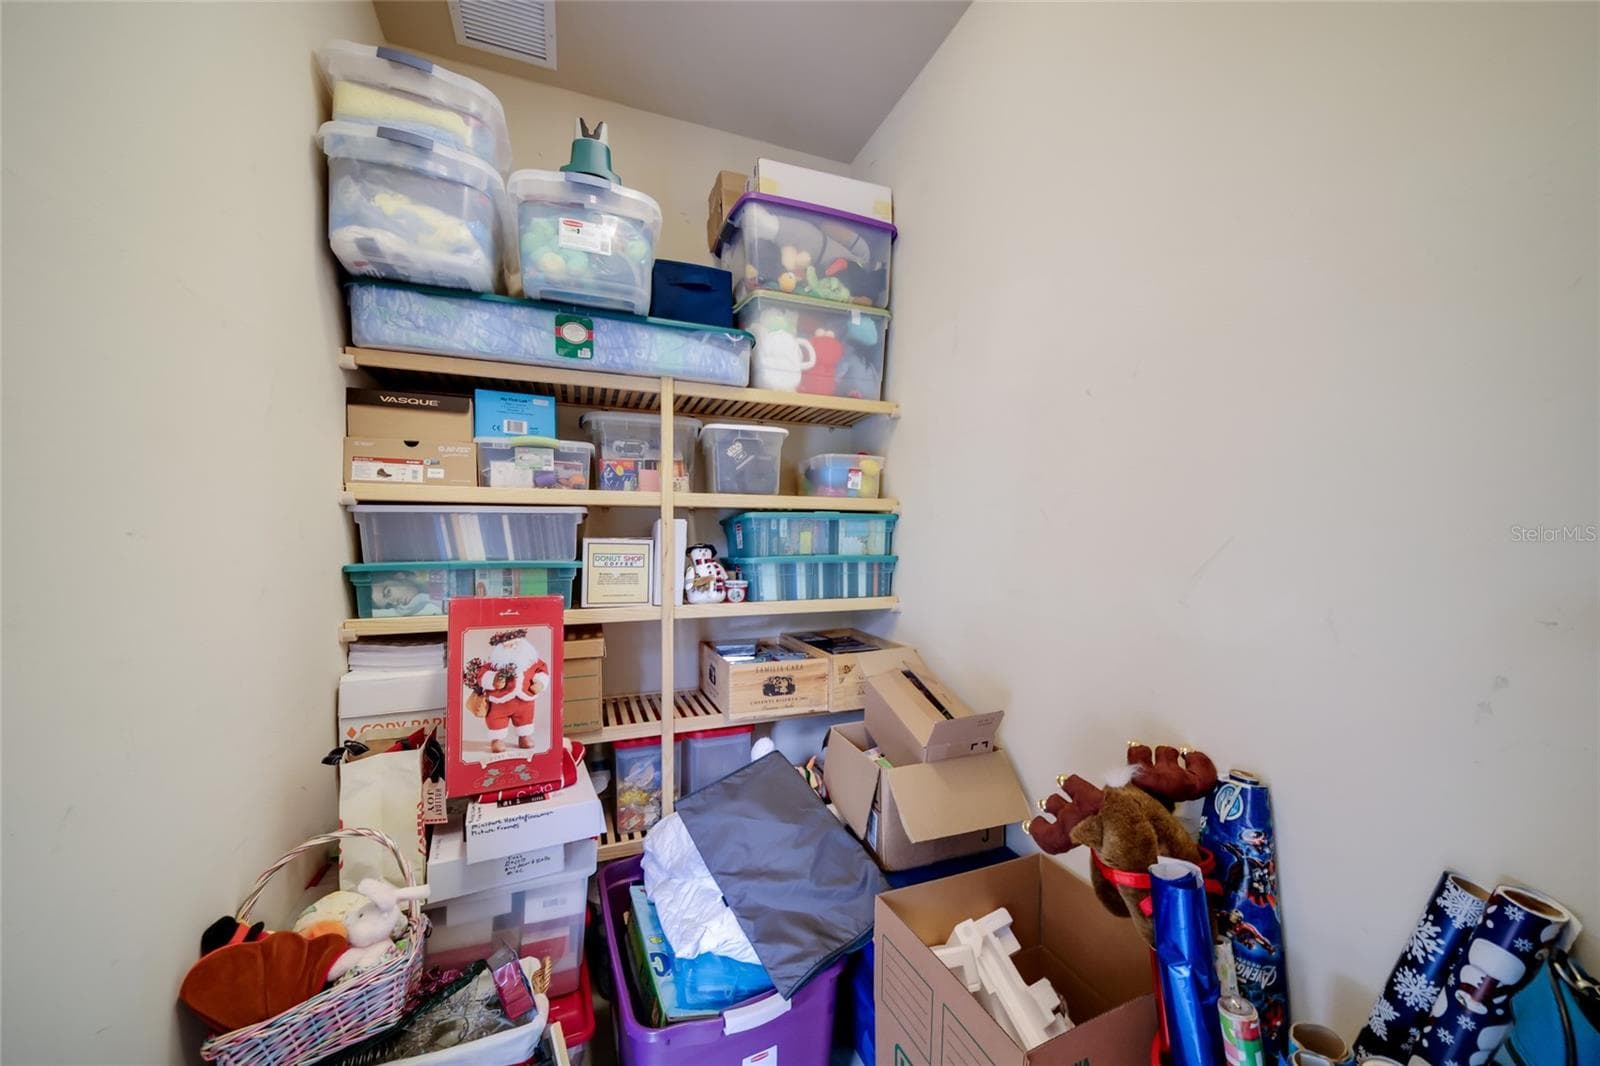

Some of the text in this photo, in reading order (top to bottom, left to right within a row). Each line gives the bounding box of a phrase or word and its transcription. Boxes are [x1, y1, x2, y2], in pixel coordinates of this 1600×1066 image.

[379, 395, 439, 407] VASQUE
[594, 554, 621, 562] DONUT
[427, 791, 435, 811] JOY
